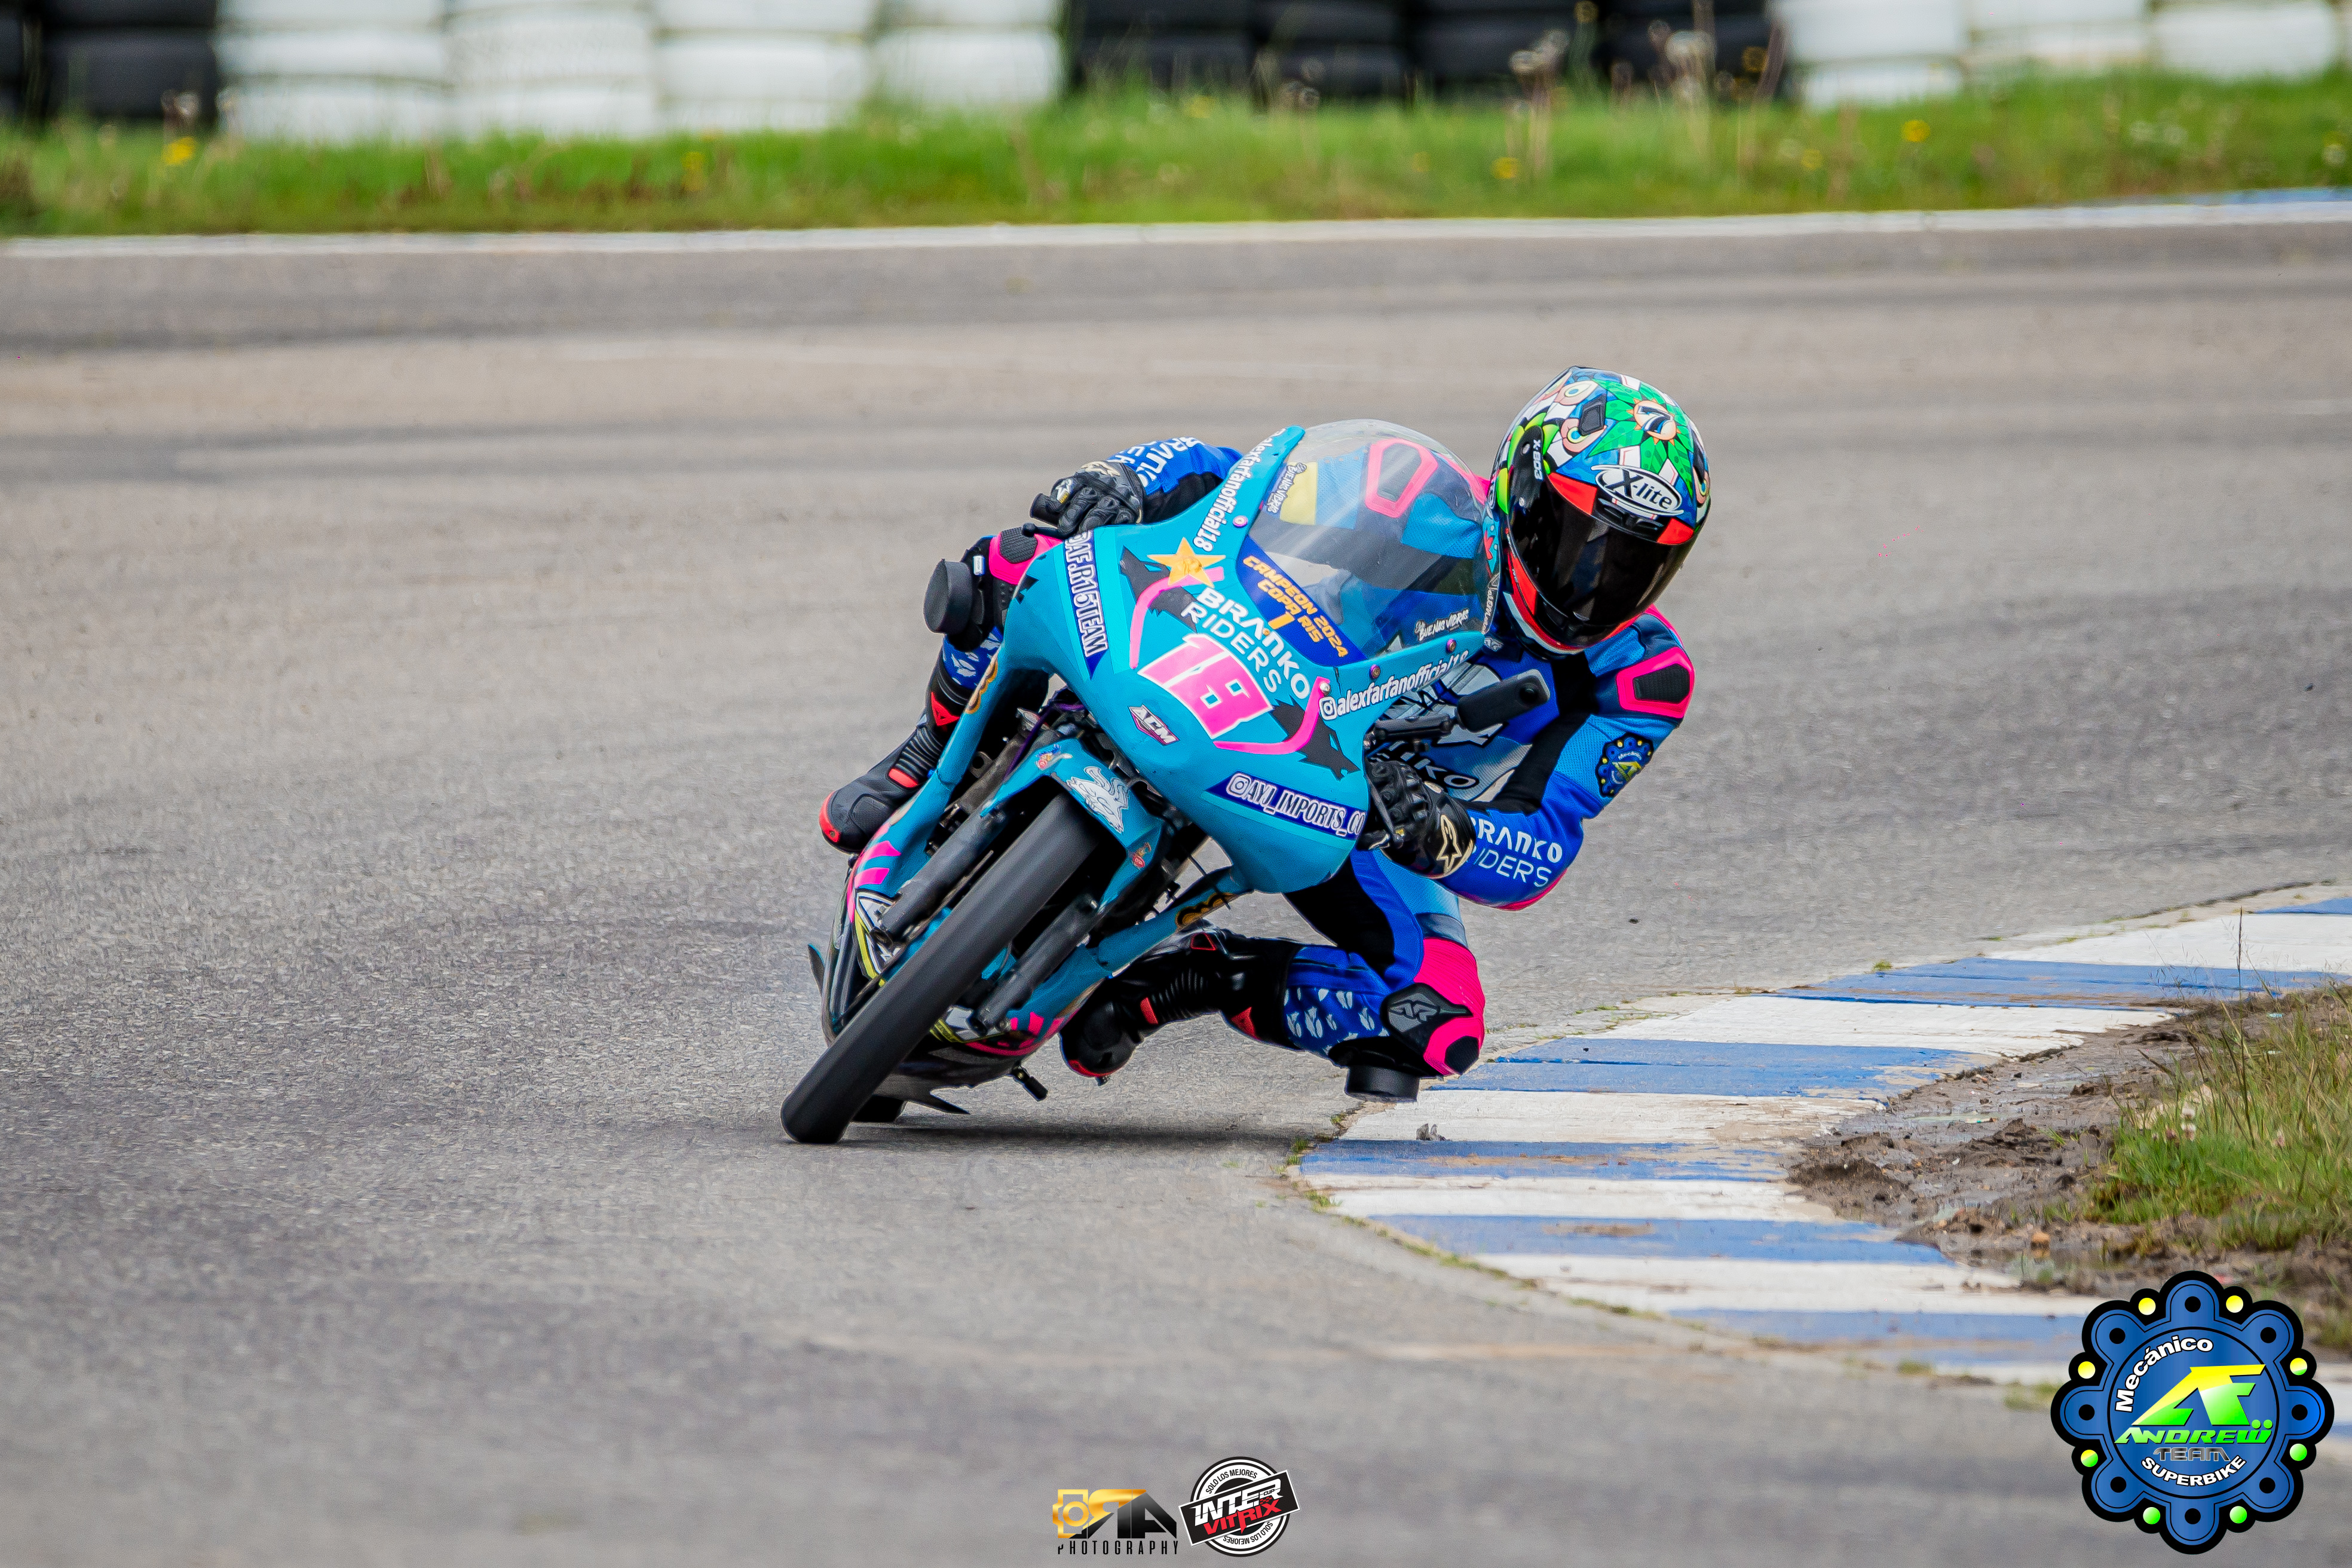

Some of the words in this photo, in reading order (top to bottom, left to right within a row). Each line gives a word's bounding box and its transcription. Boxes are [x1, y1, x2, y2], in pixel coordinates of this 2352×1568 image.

[1533, 439, 1544, 480] X-803
[1604, 468, 1673, 510] X-lite
[1243, 555, 1318, 615] CAMPEON
[1313, 615, 1349, 657] 2024
[1257, 579, 1302, 615] COPA
[1181, 601, 1282, 693] RIDERS
[1196, 586, 1310, 699] BRANKO
[1137, 633, 1274, 740] 18
[1129, 705, 1177, 744] ACM
[1471, 816, 1563, 863] RANKO
[1466, 844, 1552, 887] IDERS
